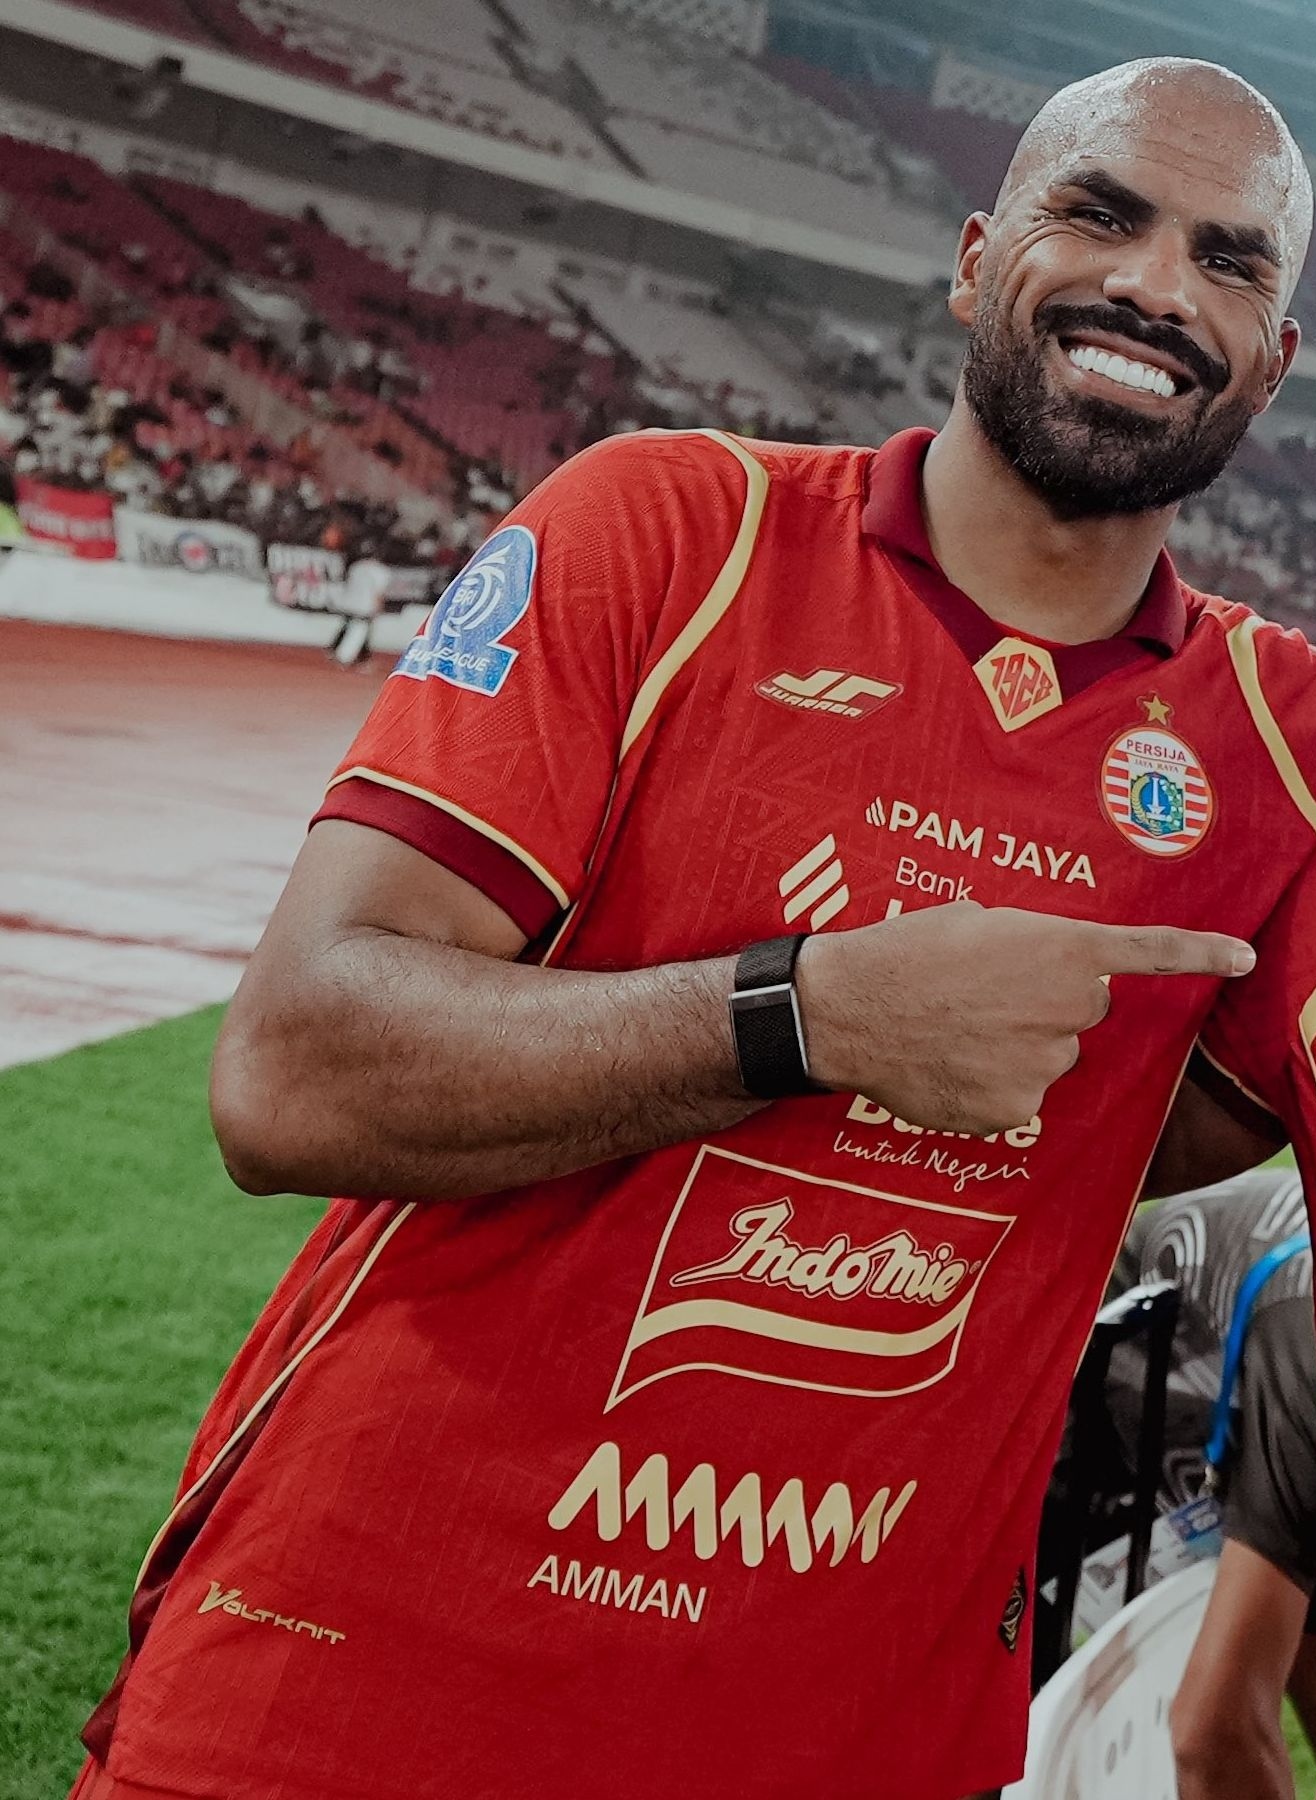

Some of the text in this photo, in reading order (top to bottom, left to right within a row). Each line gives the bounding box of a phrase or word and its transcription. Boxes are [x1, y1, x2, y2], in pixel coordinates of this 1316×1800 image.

[991, 653, 1054, 721] 1928
[1126, 739, 1187, 763] PERSIJA
[1135, 758, 1179, 773] JAYA RAYA
[888, 800, 1096, 889] PAM JAYA
[896, 856, 974, 901] Bank
[833, 1131, 1030, 1193] Untuk Negeri
[527, 1554, 707, 1622] AMMAN
